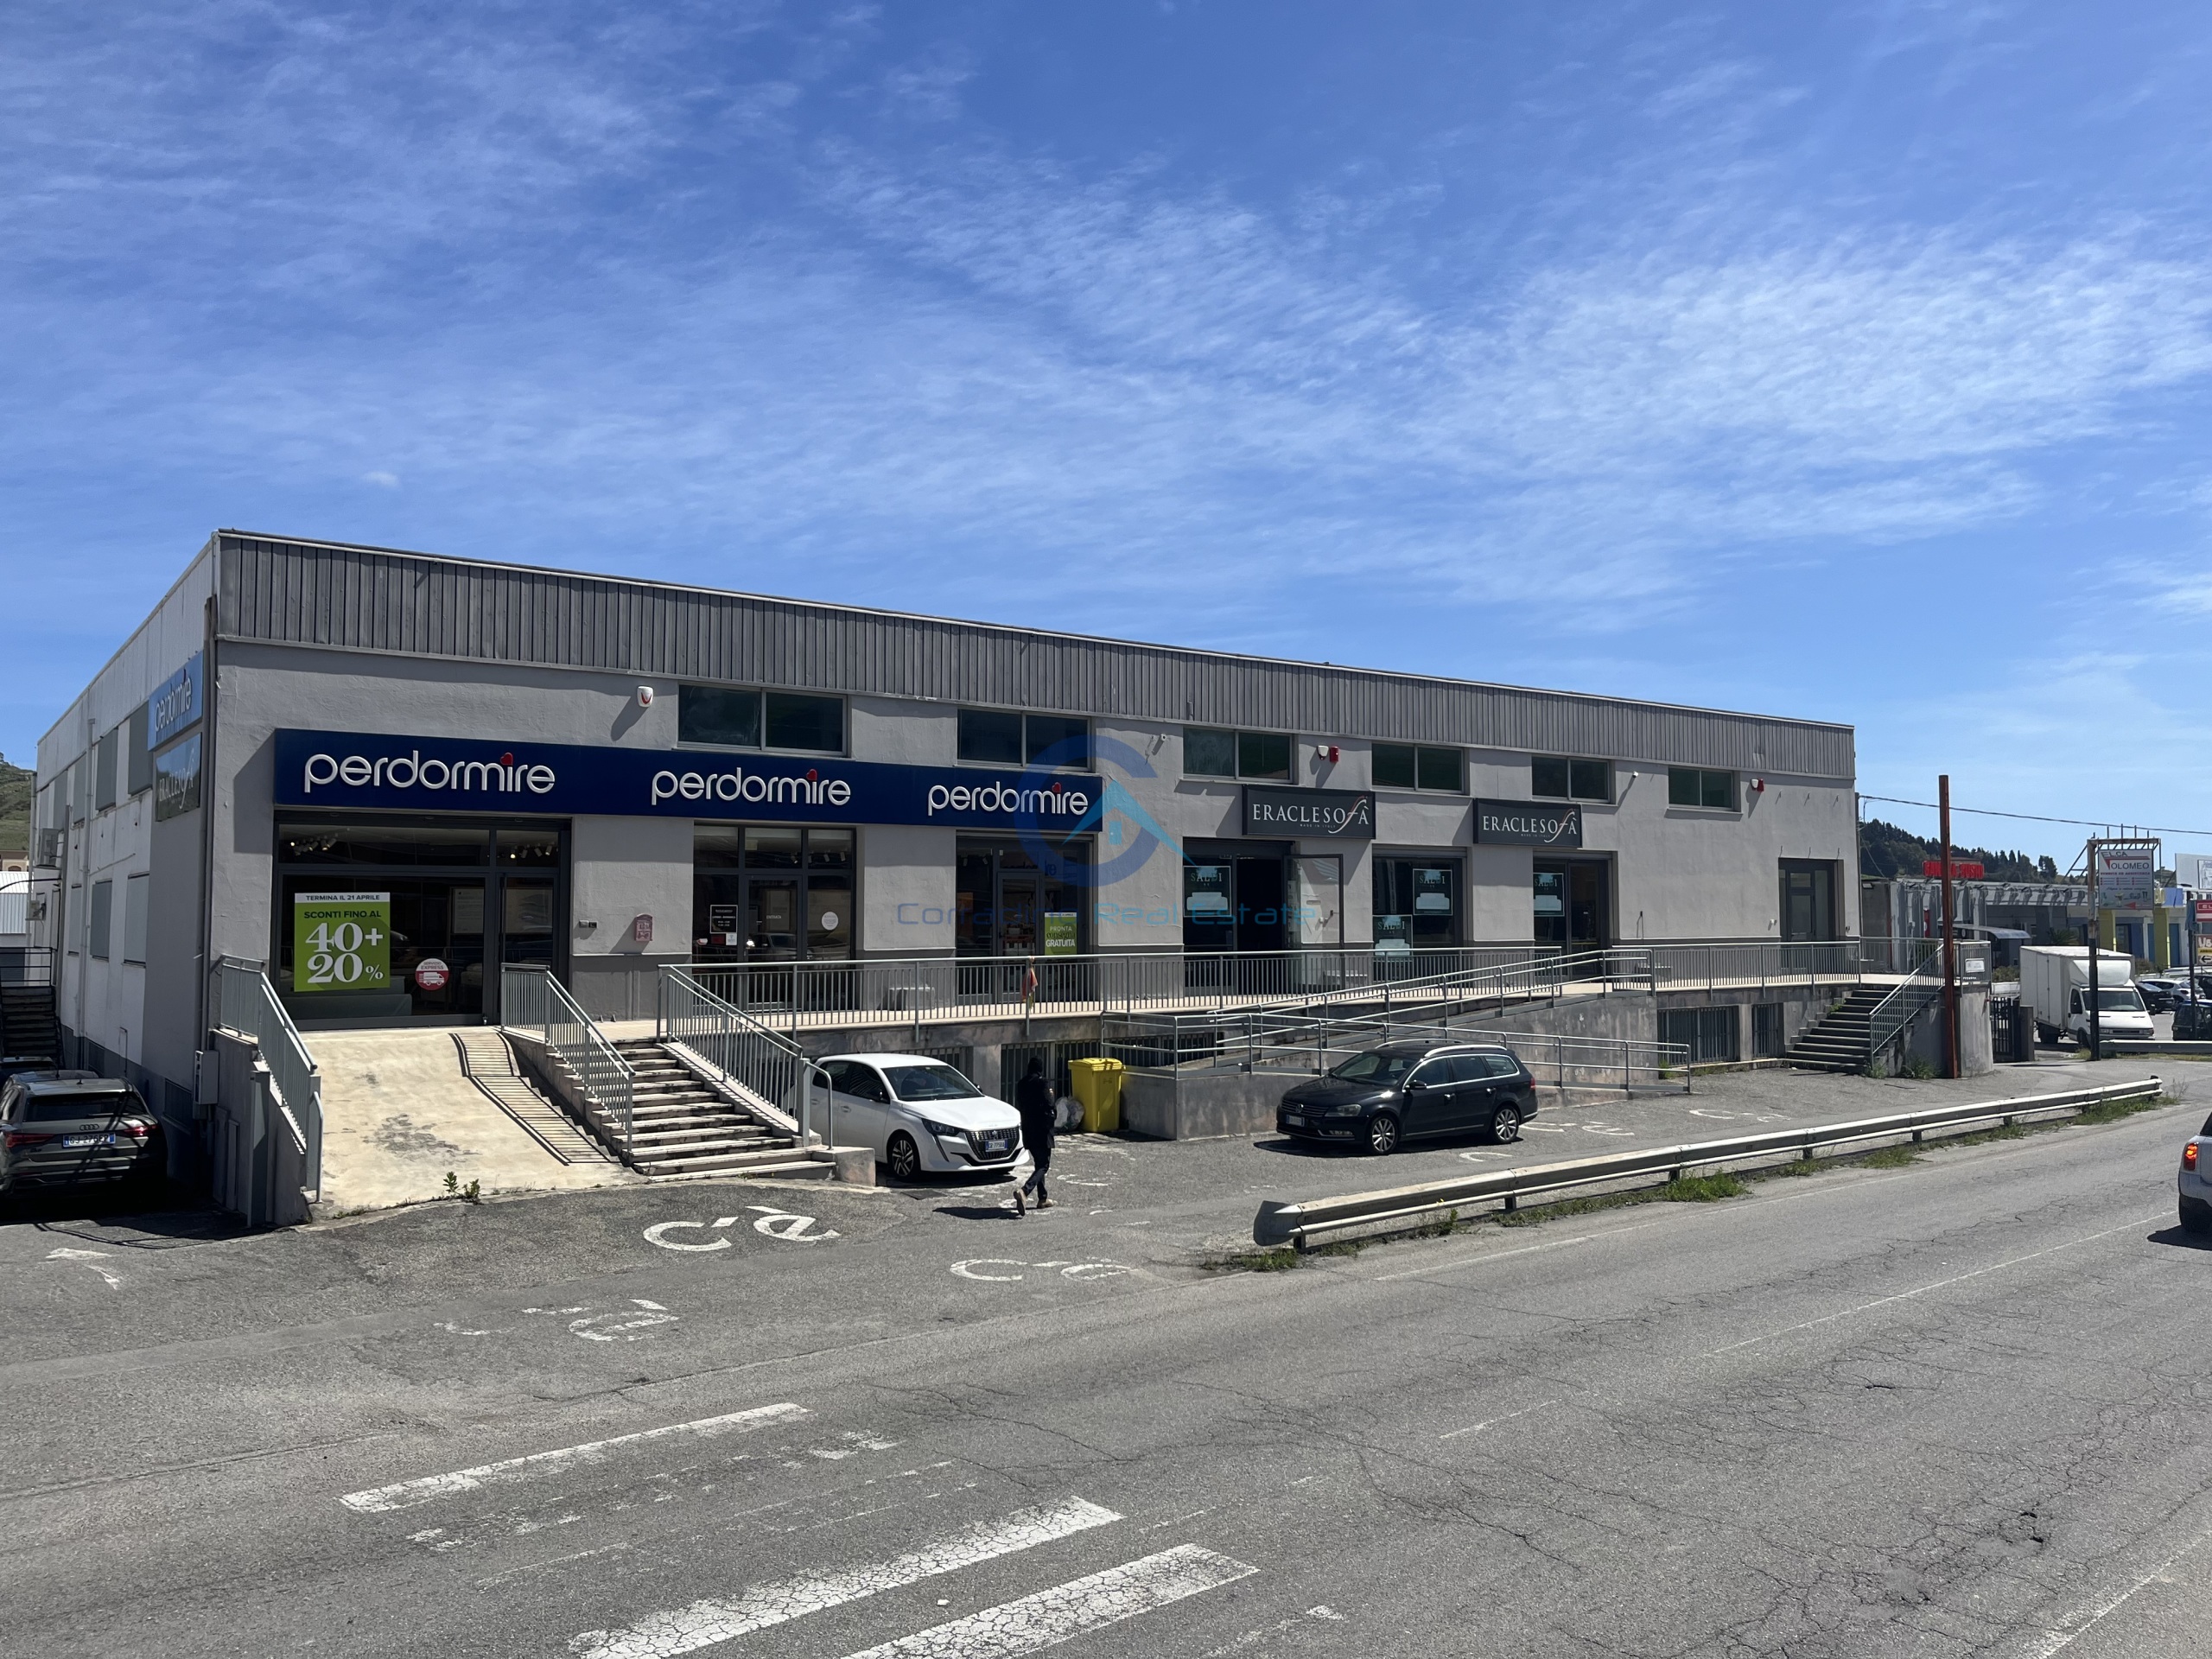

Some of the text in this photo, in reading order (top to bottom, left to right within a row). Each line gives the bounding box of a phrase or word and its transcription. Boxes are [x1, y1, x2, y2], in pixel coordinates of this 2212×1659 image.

[304, 750, 556, 793] perdormire
[651, 767, 851, 806] perdormire
[927, 781, 1089, 817] perdormire
[307, 953, 384, 983] 20%
